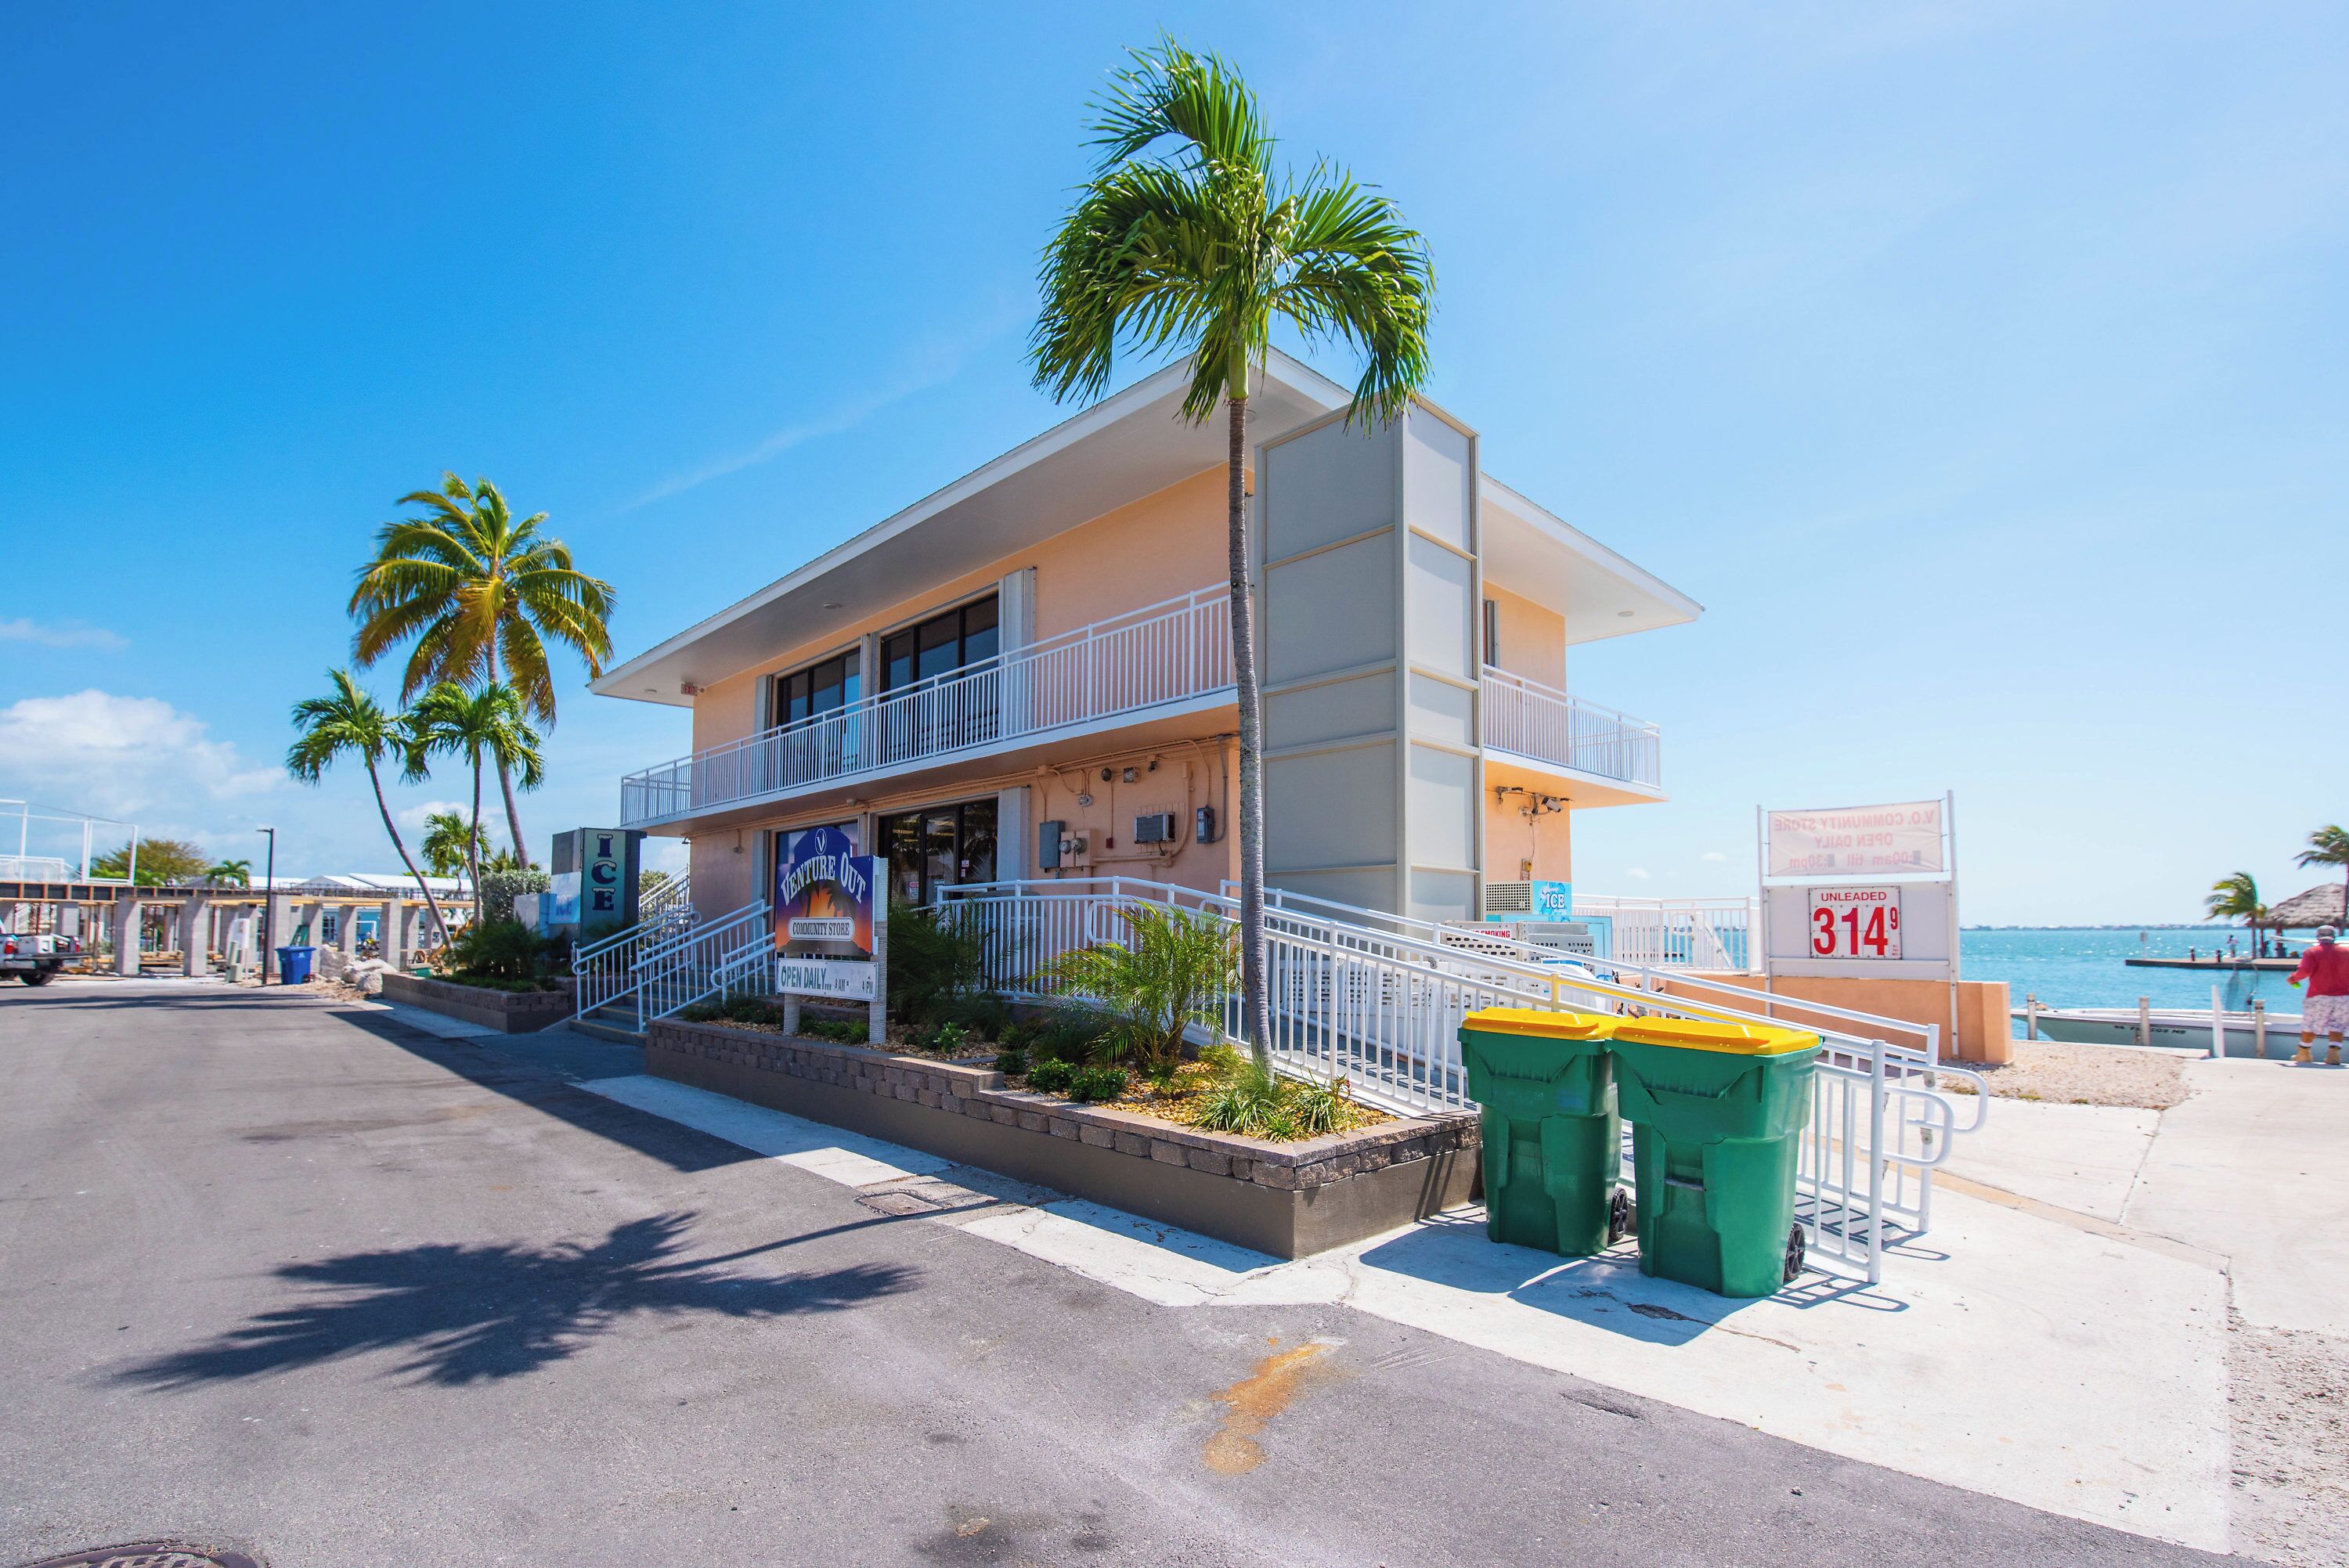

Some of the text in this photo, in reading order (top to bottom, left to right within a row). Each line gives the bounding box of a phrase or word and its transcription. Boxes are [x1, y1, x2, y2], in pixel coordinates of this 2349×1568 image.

[591, 833, 617, 910] ICE
[781, 851, 867, 907] VENTURE OUT
[1546, 892, 1564, 909] ICE
[1820, 891, 1887, 902] UNLEADED
[792, 921, 850, 936] COMMUNITY STORE
[1813, 907, 1898, 956] 314 9
[781, 965, 802, 988] OPEN
[838, 979, 846, 992] AM
